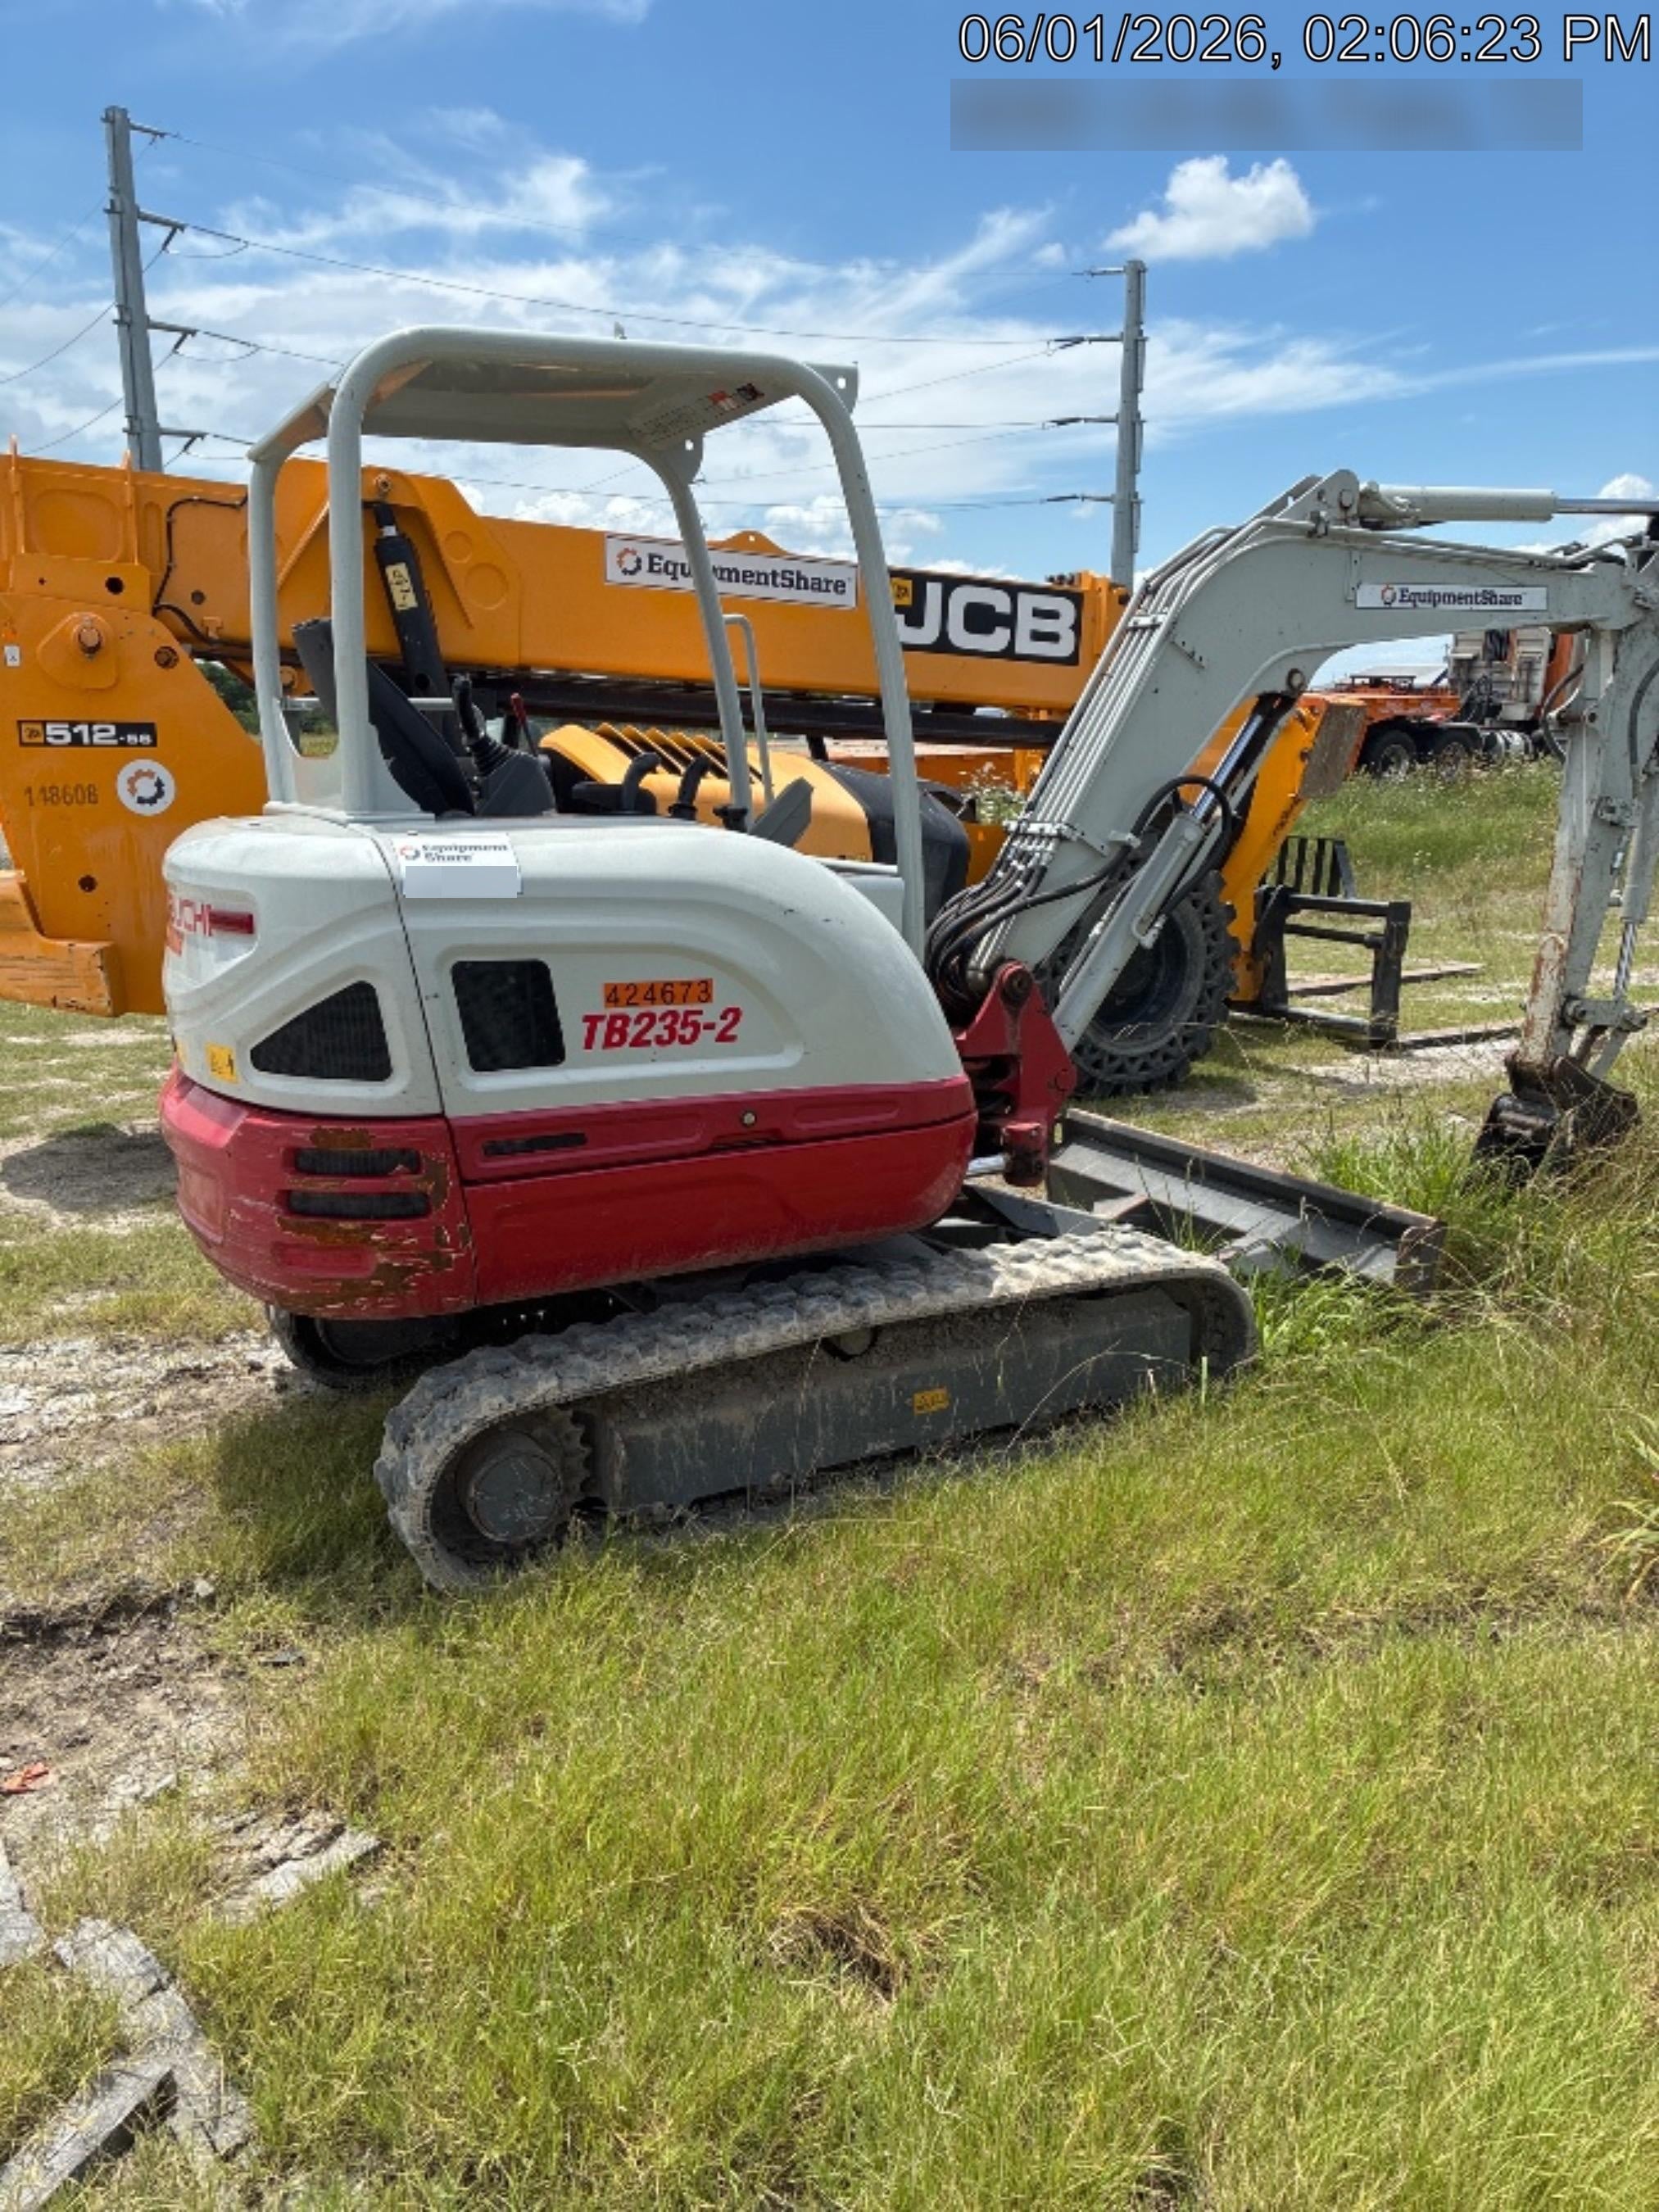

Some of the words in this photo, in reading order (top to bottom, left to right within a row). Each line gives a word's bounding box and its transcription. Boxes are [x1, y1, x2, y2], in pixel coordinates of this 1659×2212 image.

[1398, 587, 1523, 608] EquipmentShare
[895, 582, 1076, 657] JCB
[606, 980, 712, 1008] 424673
[582, 1007, 743, 1049] TB235-2
